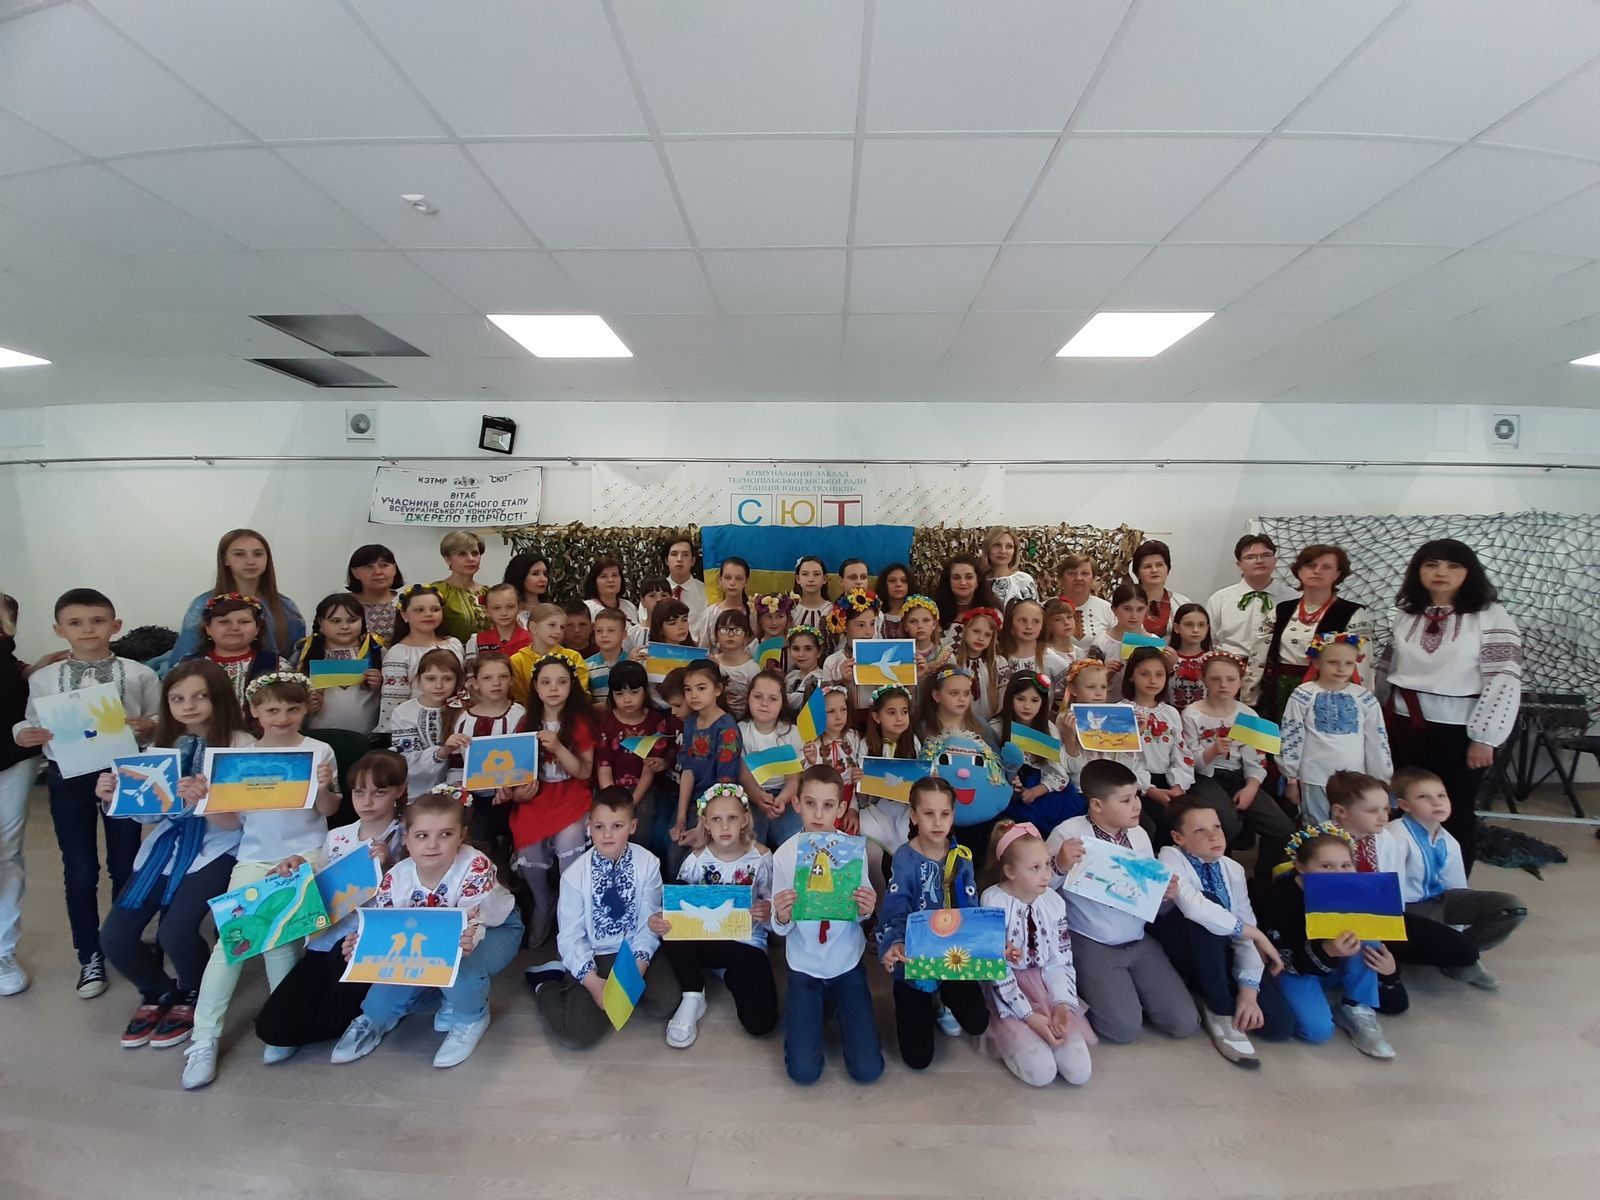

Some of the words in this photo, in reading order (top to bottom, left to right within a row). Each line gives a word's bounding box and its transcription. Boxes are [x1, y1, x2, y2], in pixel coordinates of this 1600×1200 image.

[418, 476, 447, 485] КЗТМР
[450, 492, 476, 500] ВІТАЄ
[381, 497, 439, 508] УЧАСНИКІВ
[443, 500, 499, 508] ОБЛАСНОГО
[501, 498, 528, 507] ЕТАПУ
[389, 505, 464, 514] ВСЕУКРАЇНСЬКОГО
[467, 508, 506, 516] КОНКУРСУ
[738, 499, 860, 526] СЮТ
[401, 512, 461, 523] "ДЖЕРЕЛО
[464, 512, 528, 523] ТВОРЧОСТІ"
